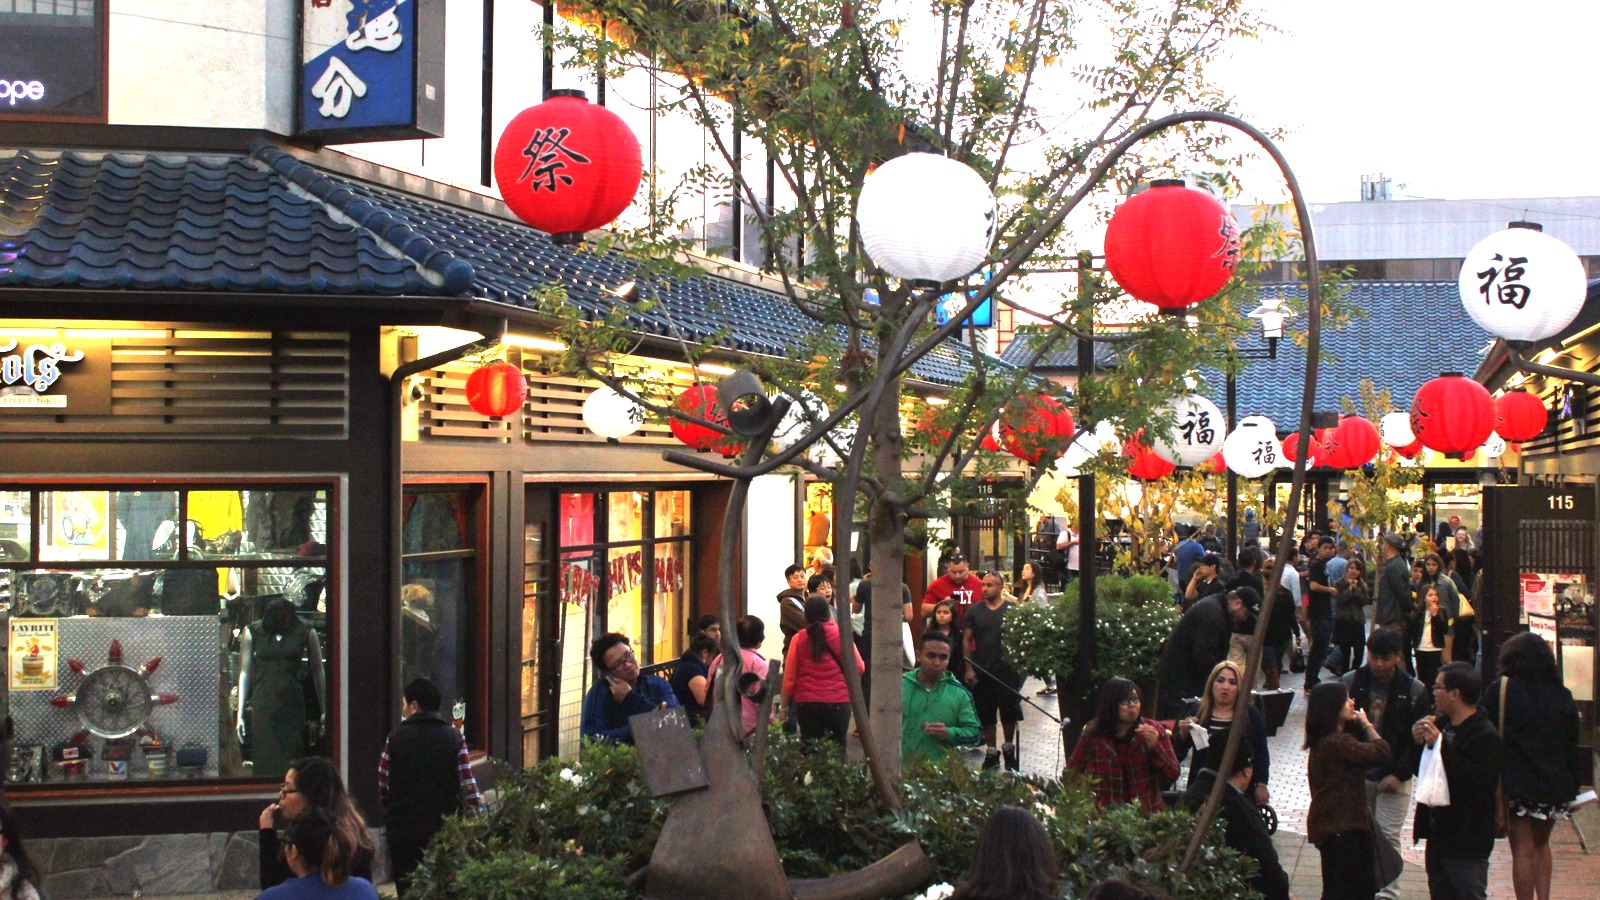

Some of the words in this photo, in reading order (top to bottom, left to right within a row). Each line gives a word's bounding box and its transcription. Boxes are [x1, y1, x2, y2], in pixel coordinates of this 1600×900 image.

[0, 80, 45, 105] ope
[516, 127, 592, 193] 祭
[1477, 253, 1531, 309] 福
[0, 343, 84, 392] ols
[1179, 411, 1215, 445] 福
[1252, 441, 1275, 465] 福
[978, 485, 992, 494] 116
[1547, 495, 1574, 509] 115
